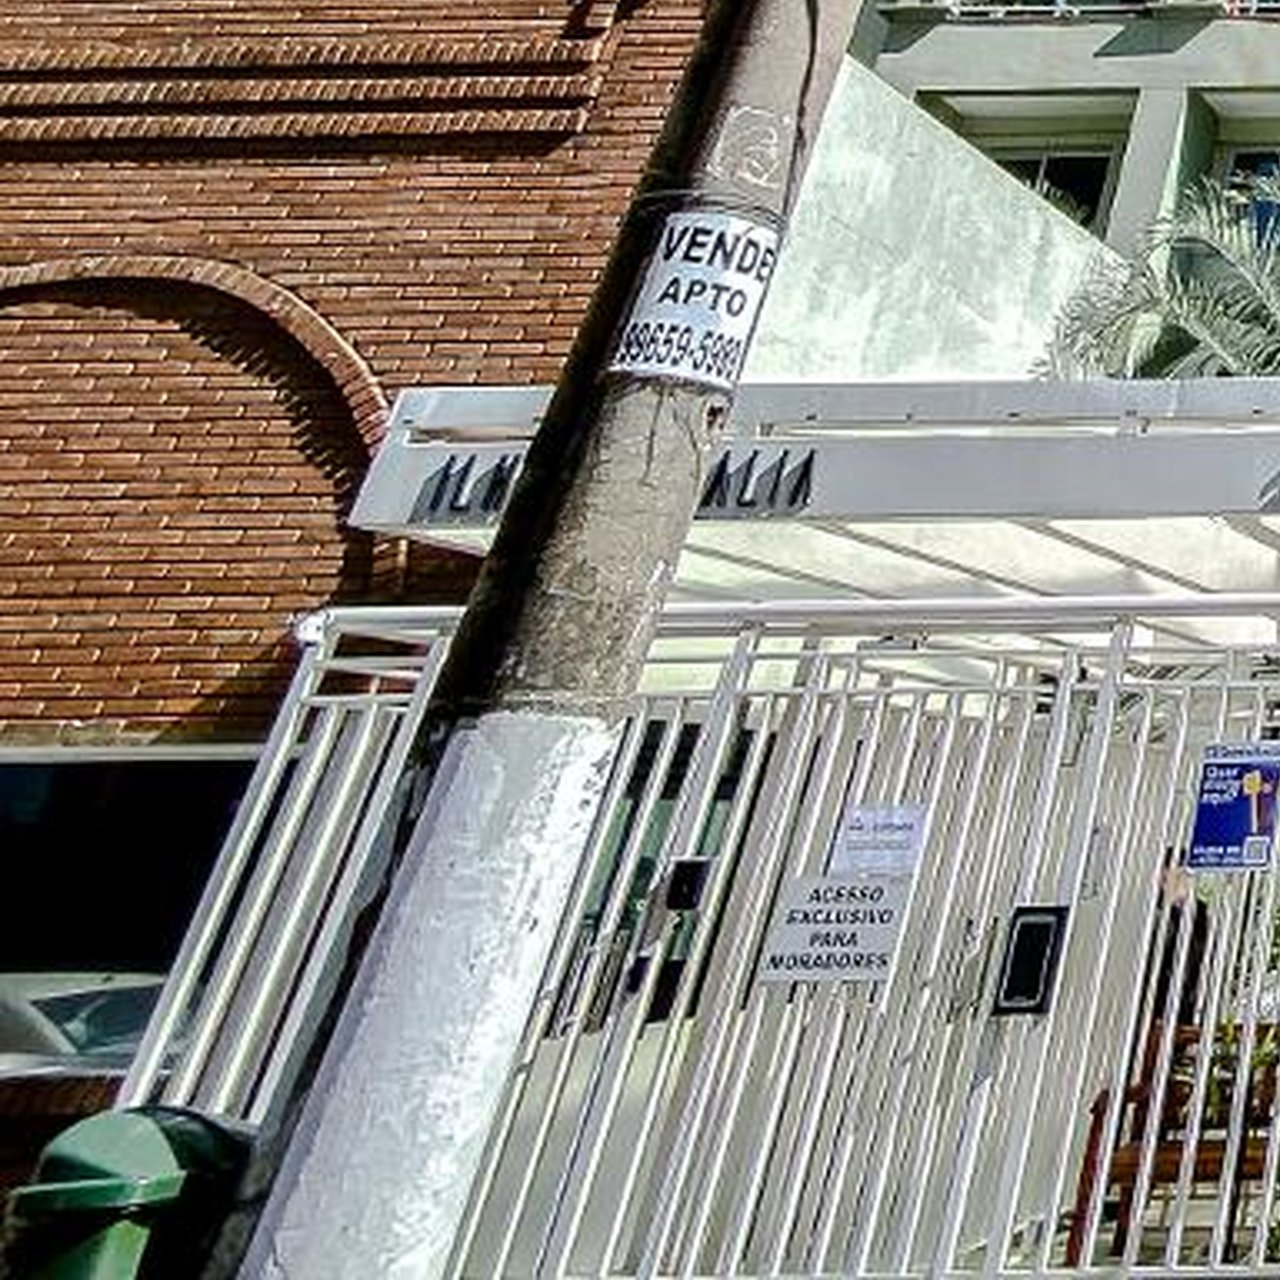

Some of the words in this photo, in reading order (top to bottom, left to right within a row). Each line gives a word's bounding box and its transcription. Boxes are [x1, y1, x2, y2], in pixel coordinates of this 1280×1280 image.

[663, 226, 778, 282] VENDE
[657, 276, 748, 317] APTO
[806, 885, 884, 904] ACESSO
[785, 909, 894, 925] EXCLUSIVO
[809, 931, 858, 948] PARA
[765, 952, 889, 970] MORADORES
